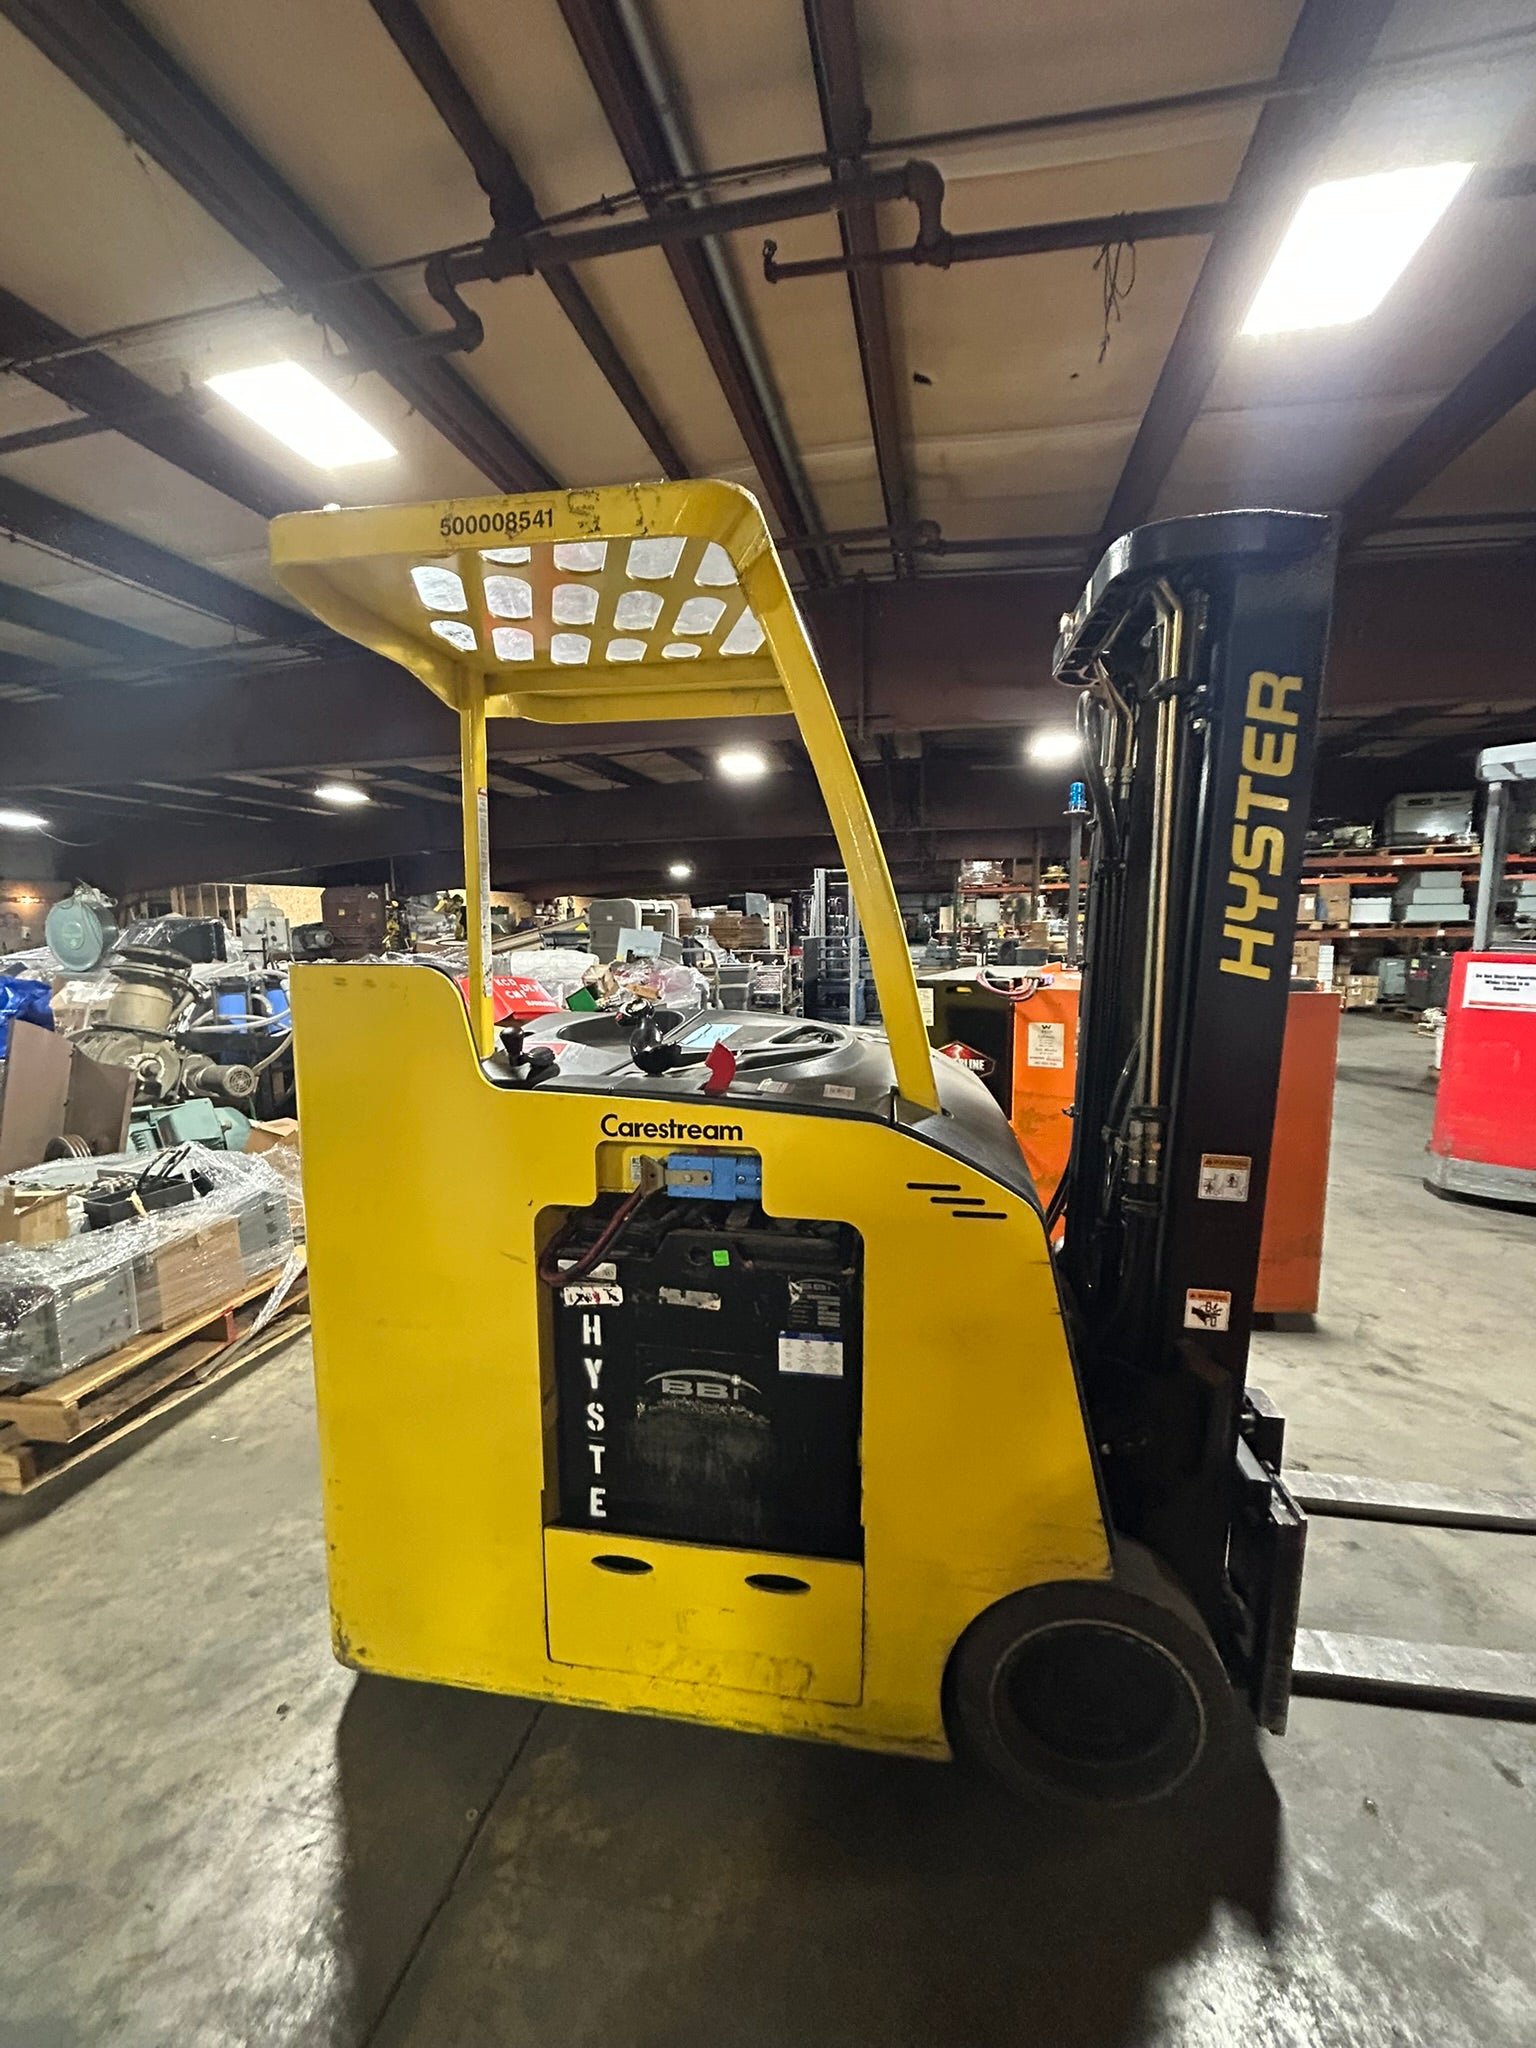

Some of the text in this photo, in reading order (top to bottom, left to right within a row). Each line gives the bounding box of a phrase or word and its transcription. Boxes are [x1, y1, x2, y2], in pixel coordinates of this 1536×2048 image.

[440, 508, 553, 537] 500008541
[1219, 670, 1303, 981] HYSTER
[600, 1113, 743, 1141] Carestream
